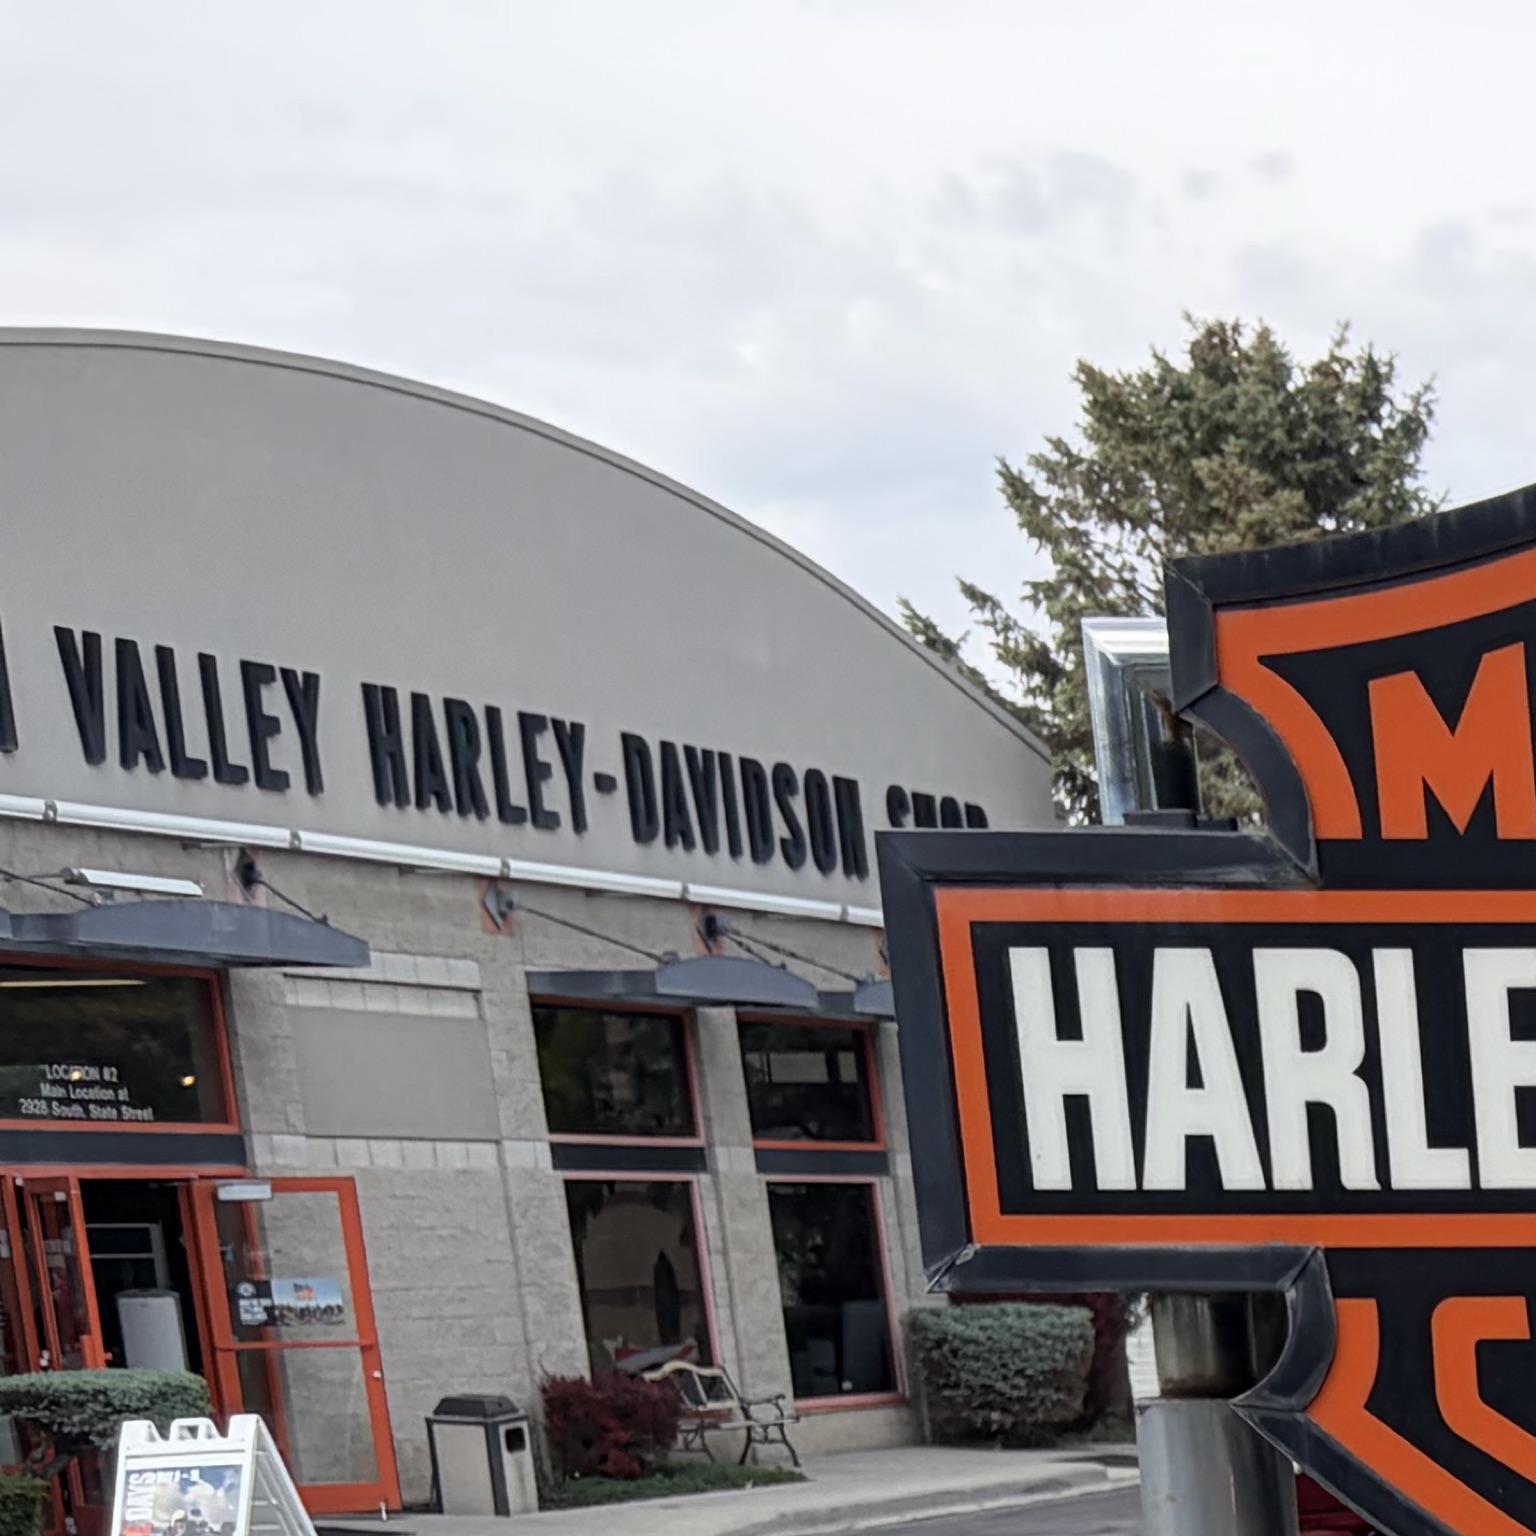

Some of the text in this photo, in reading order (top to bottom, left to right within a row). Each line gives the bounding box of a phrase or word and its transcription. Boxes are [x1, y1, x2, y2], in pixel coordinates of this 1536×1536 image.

[54, 625, 324, 797] VALLEY
[361, 681, 869, 880] HARLEY-DAVIDSON
[68, 1084, 115, 1100] Location
